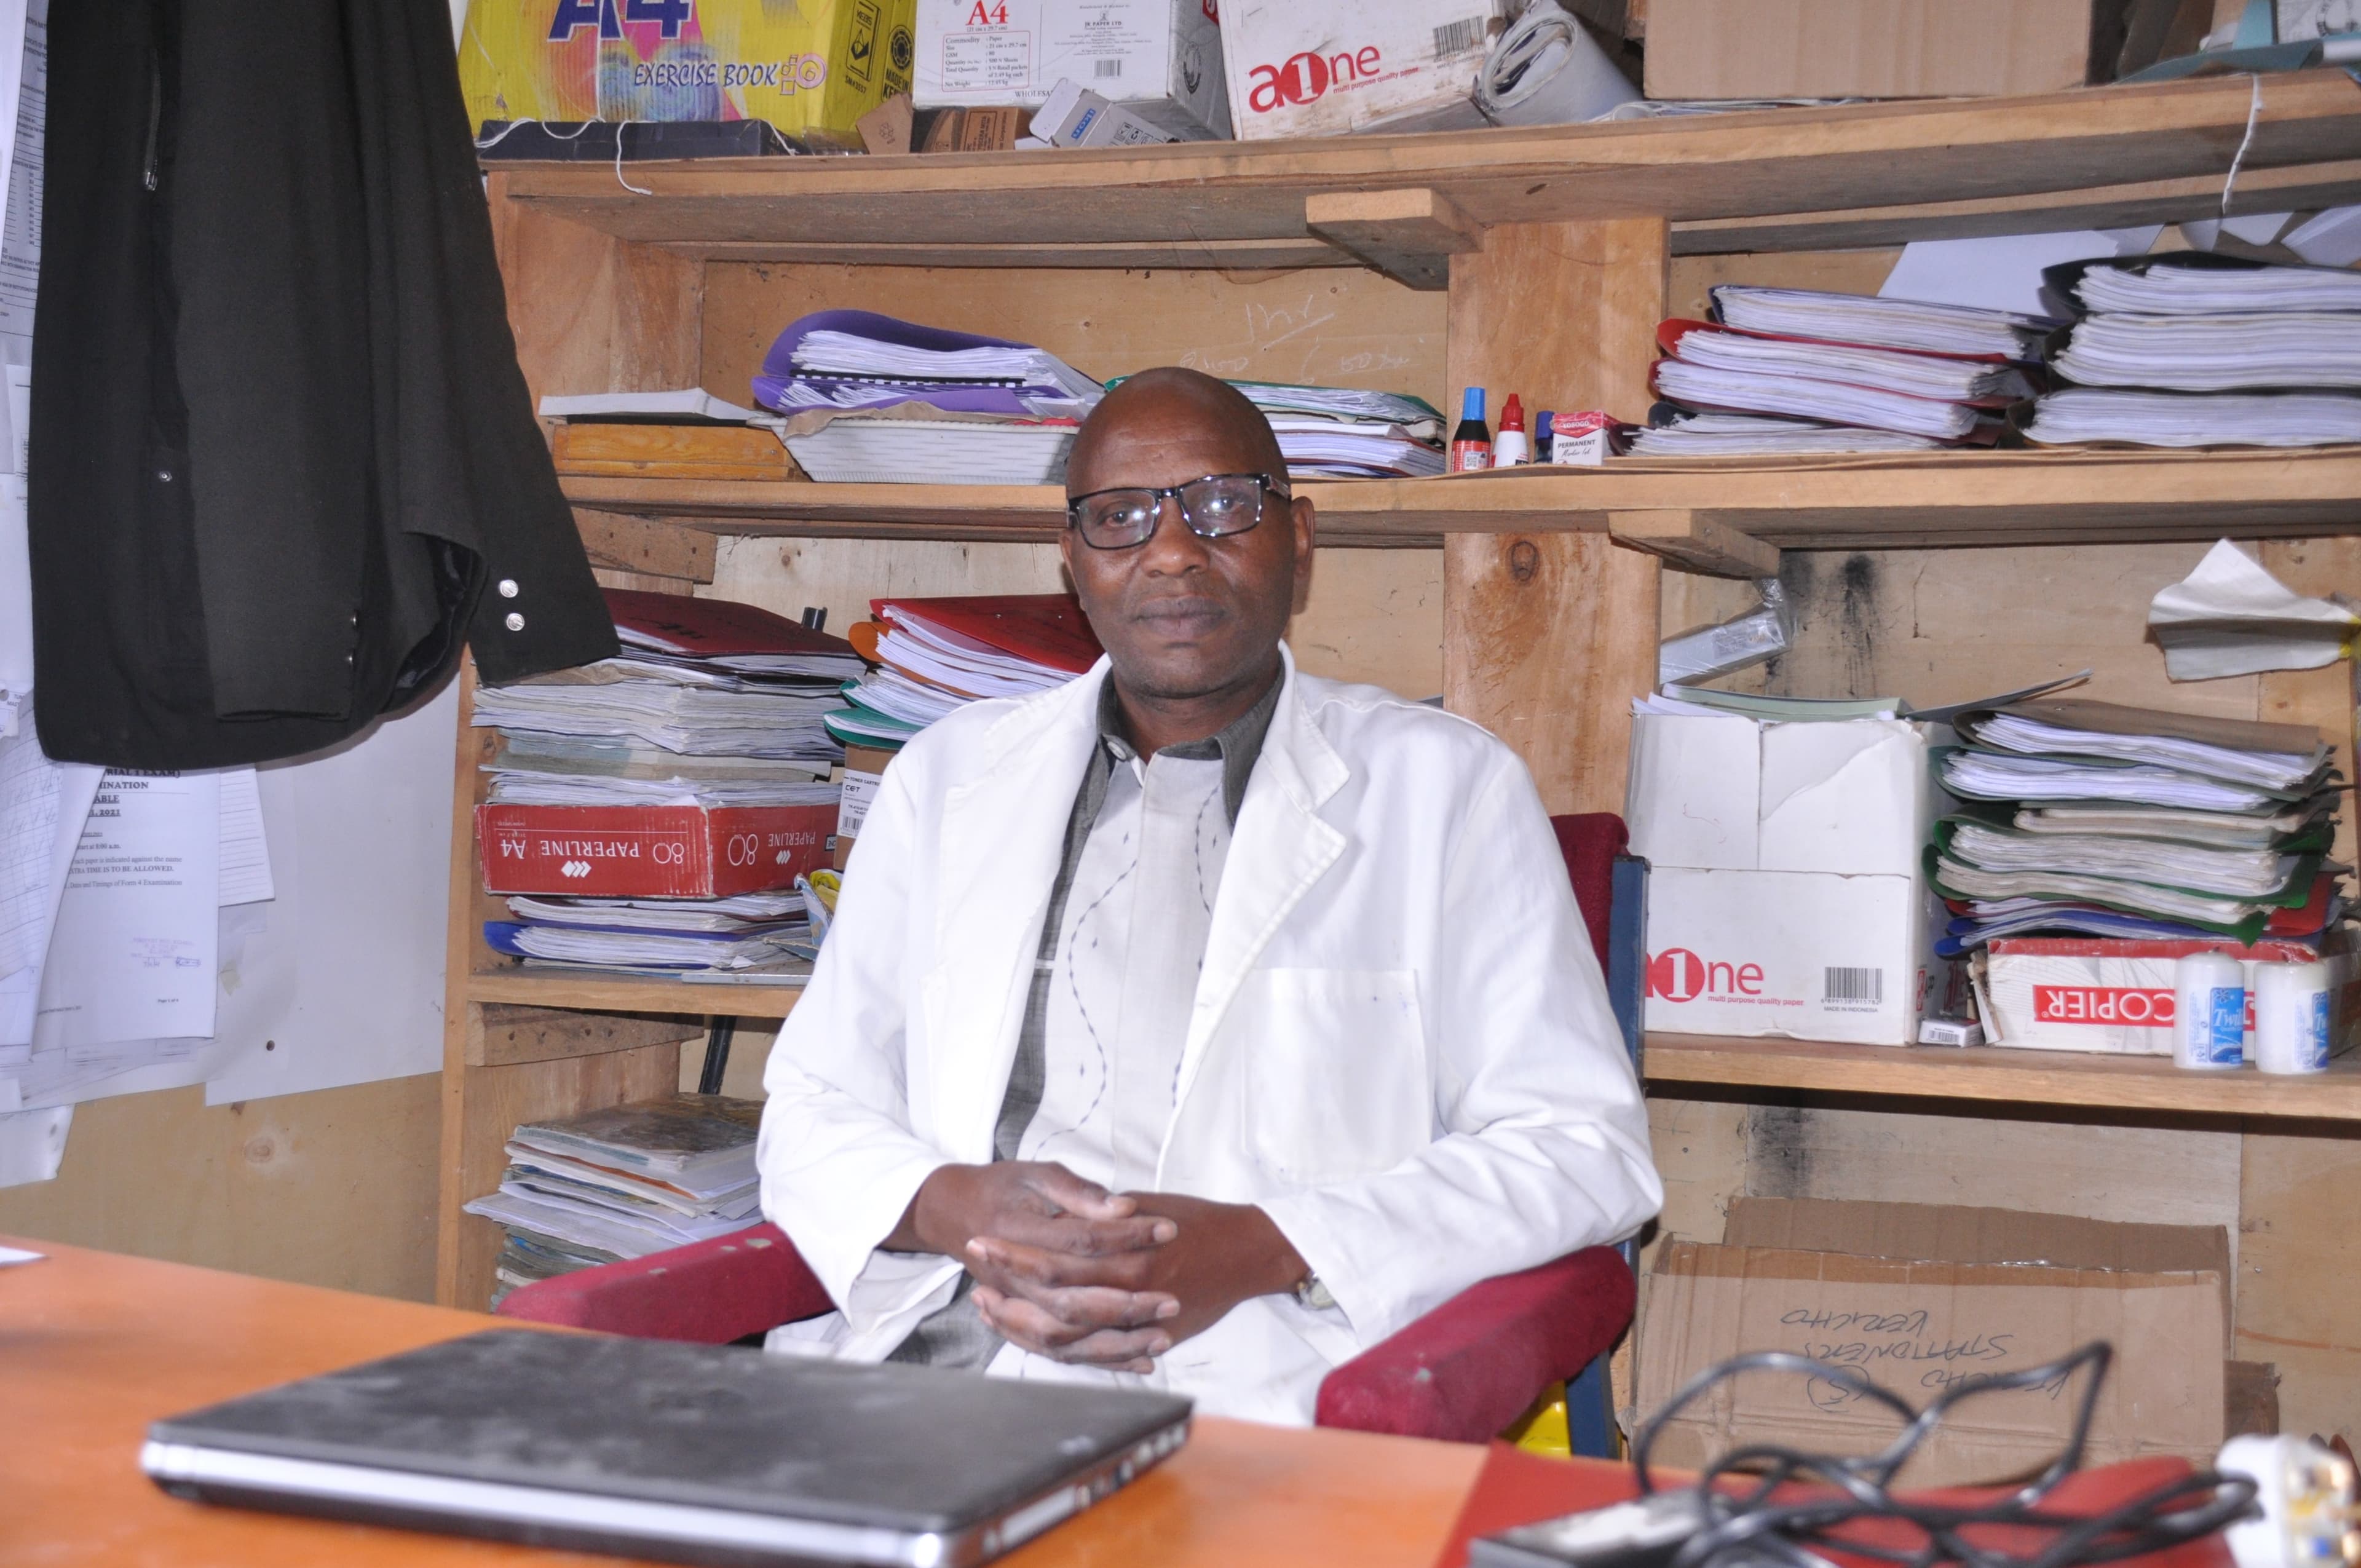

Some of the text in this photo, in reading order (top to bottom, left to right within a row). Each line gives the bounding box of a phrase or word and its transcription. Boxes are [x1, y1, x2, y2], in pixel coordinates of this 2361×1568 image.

[965, 0, 1010, 25] A4
[634, 63, 778, 87] EXERCISE BOOK
[885, 68, 902, 89] MADE
[1333, 85, 1350, 93] multi
[1351, 79, 1376, 90] purpose
[1377, 72, 1398, 83] quality
[1558, 439, 1596, 448] PERMANENT
[501, 840, 684, 864] 80 PAPERLINE A4
[729, 832, 816, 866] 80 PAPERLINE
[1757, 997, 1781, 1007] quality
[1781, 1309, 1928, 1337] KERICHO
